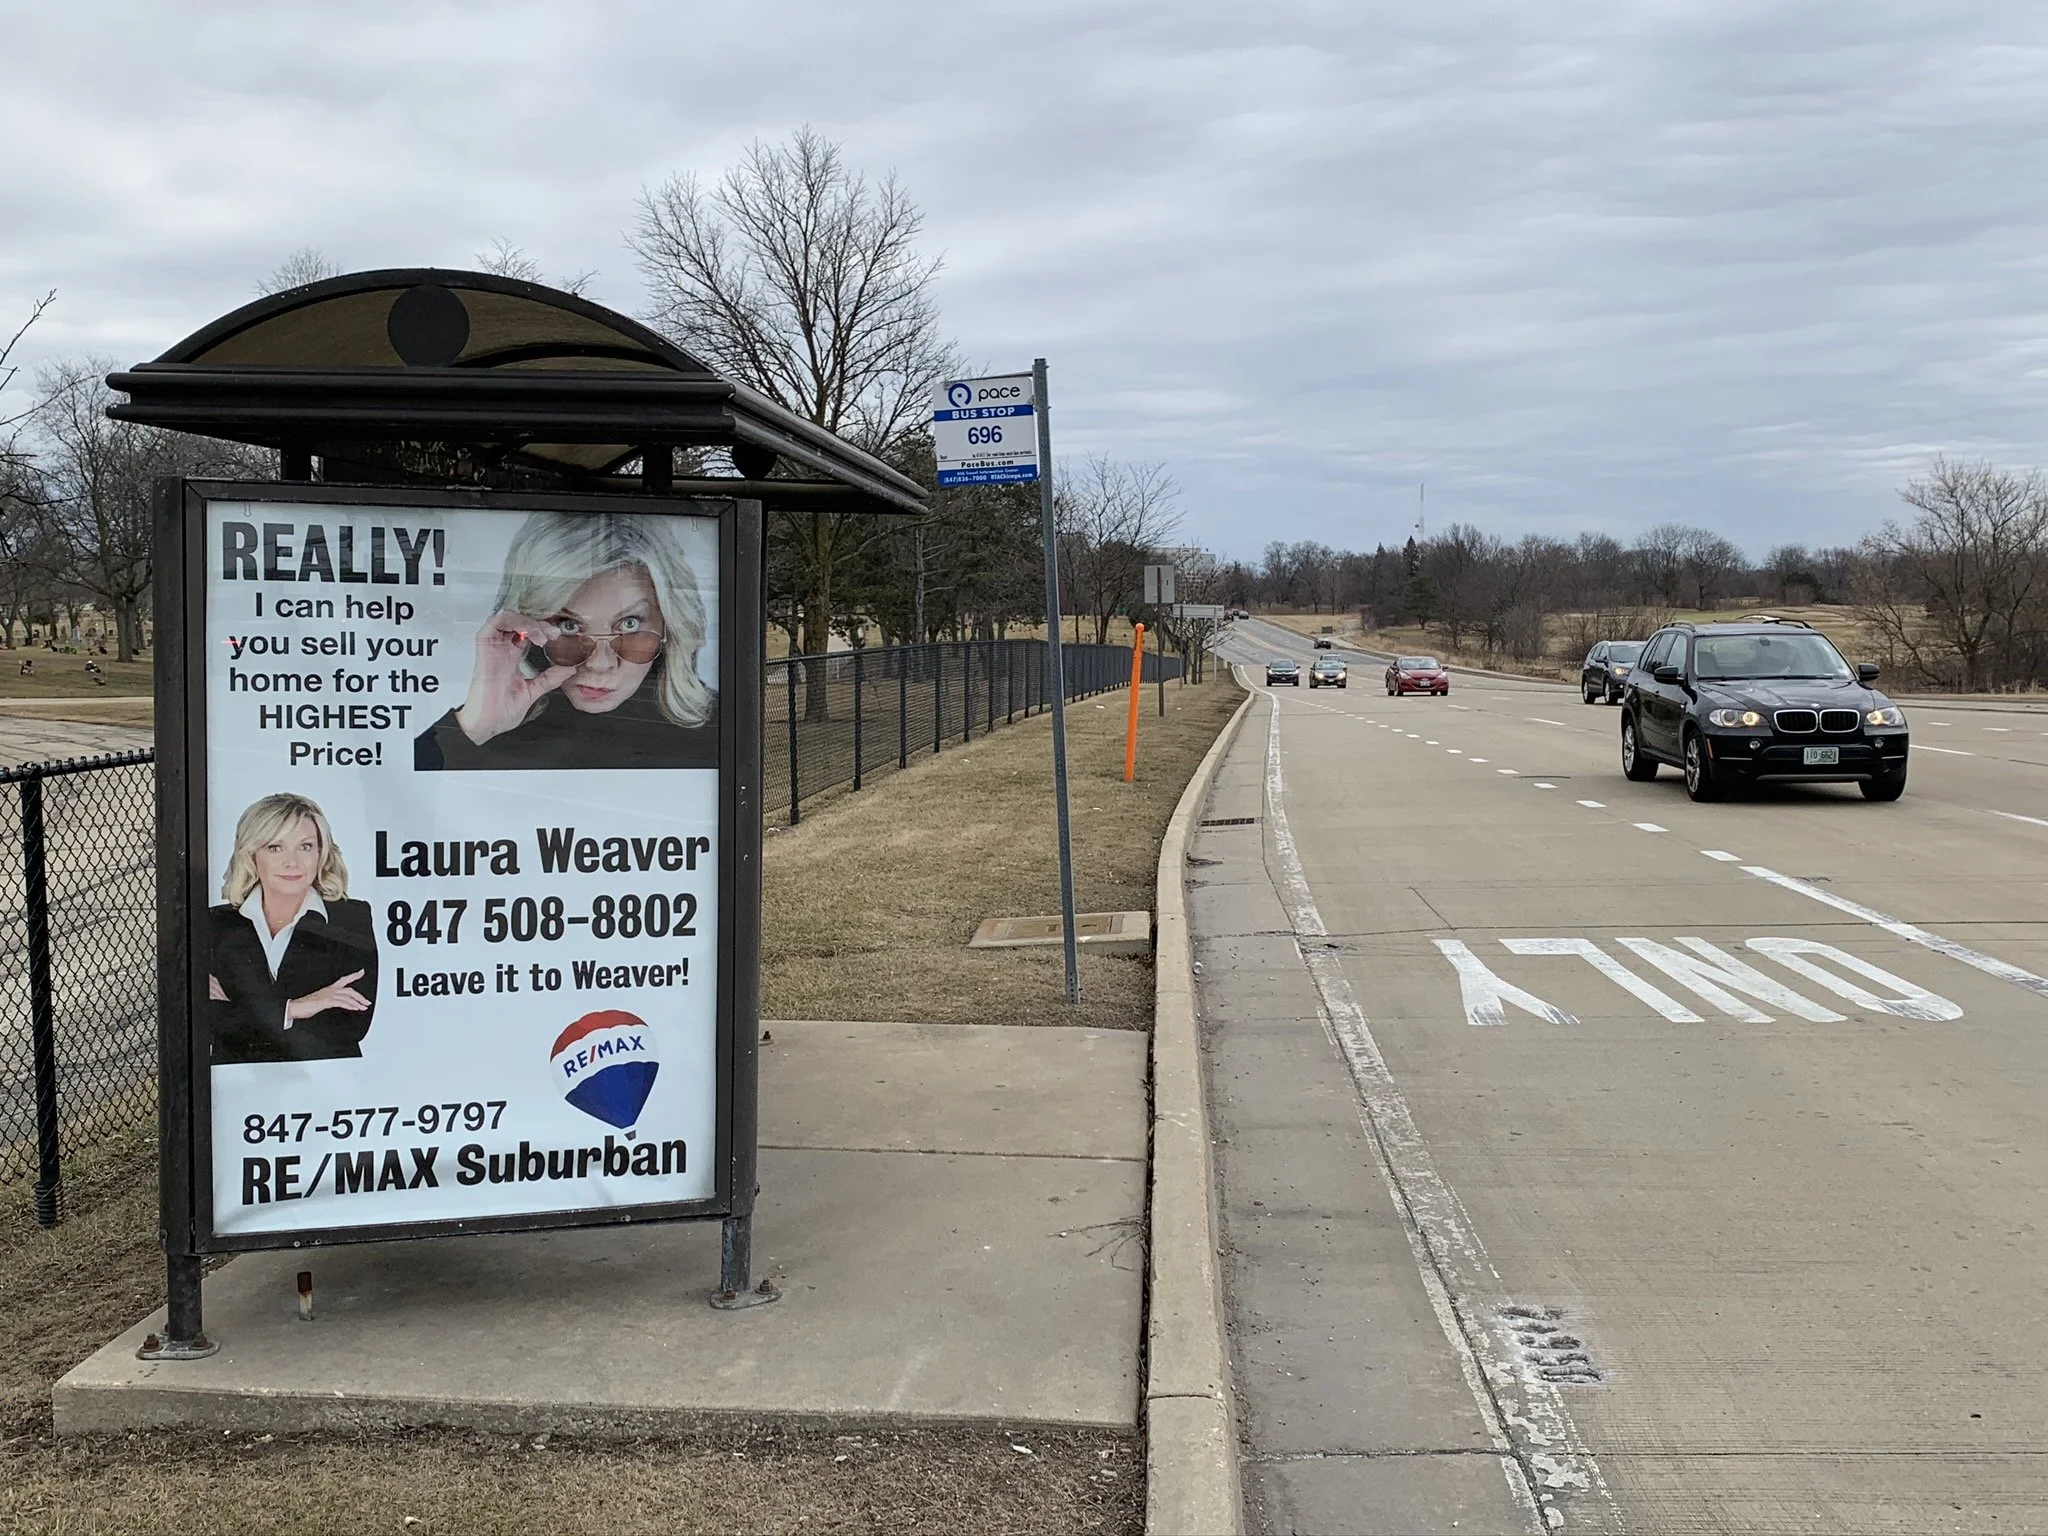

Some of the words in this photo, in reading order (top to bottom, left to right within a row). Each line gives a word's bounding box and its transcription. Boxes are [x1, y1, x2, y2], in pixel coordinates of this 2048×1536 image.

[978, 386, 1021, 402] pace
[951, 408, 978, 420] BUS
[981, 406, 1016, 417] STOP
[967, 425, 1003, 445] 696
[961, 460, 1014, 468] PaceBus.com
[222, 521, 446, 586] REALLY!
[255, 592, 263, 617] I
[275, 598, 334, 618] can
[345, 594, 415, 626] help
[228, 635, 290, 661] you
[301, 631, 357, 656] sell
[366, 637, 440, 662] your
[229, 667, 323, 693] home
[332, 668, 380, 693] for
[388, 669, 440, 693] the
[259, 704, 412, 730] HIGHEST
[290, 741, 382, 766] Price!
[375, 830, 521, 878] Laura
[536, 827, 710, 874] Weaver
[386, 899, 468, 947] 847
[483, 892, 698, 943] 508-8802
[396, 967, 485, 998] Leave
[496, 963, 519, 993] it
[528, 963, 562, 992] to
[571, 957, 689, 990] Weaver!
[1431, 936, 1964, 1026] ONLY
[563, 1035, 645, 1078] RE/MAX
[243, 1100, 508, 1144] 847-577-9797
[242, 1146, 440, 1206] RE/MAX
[456, 1135, 687, 1186] Suburban
